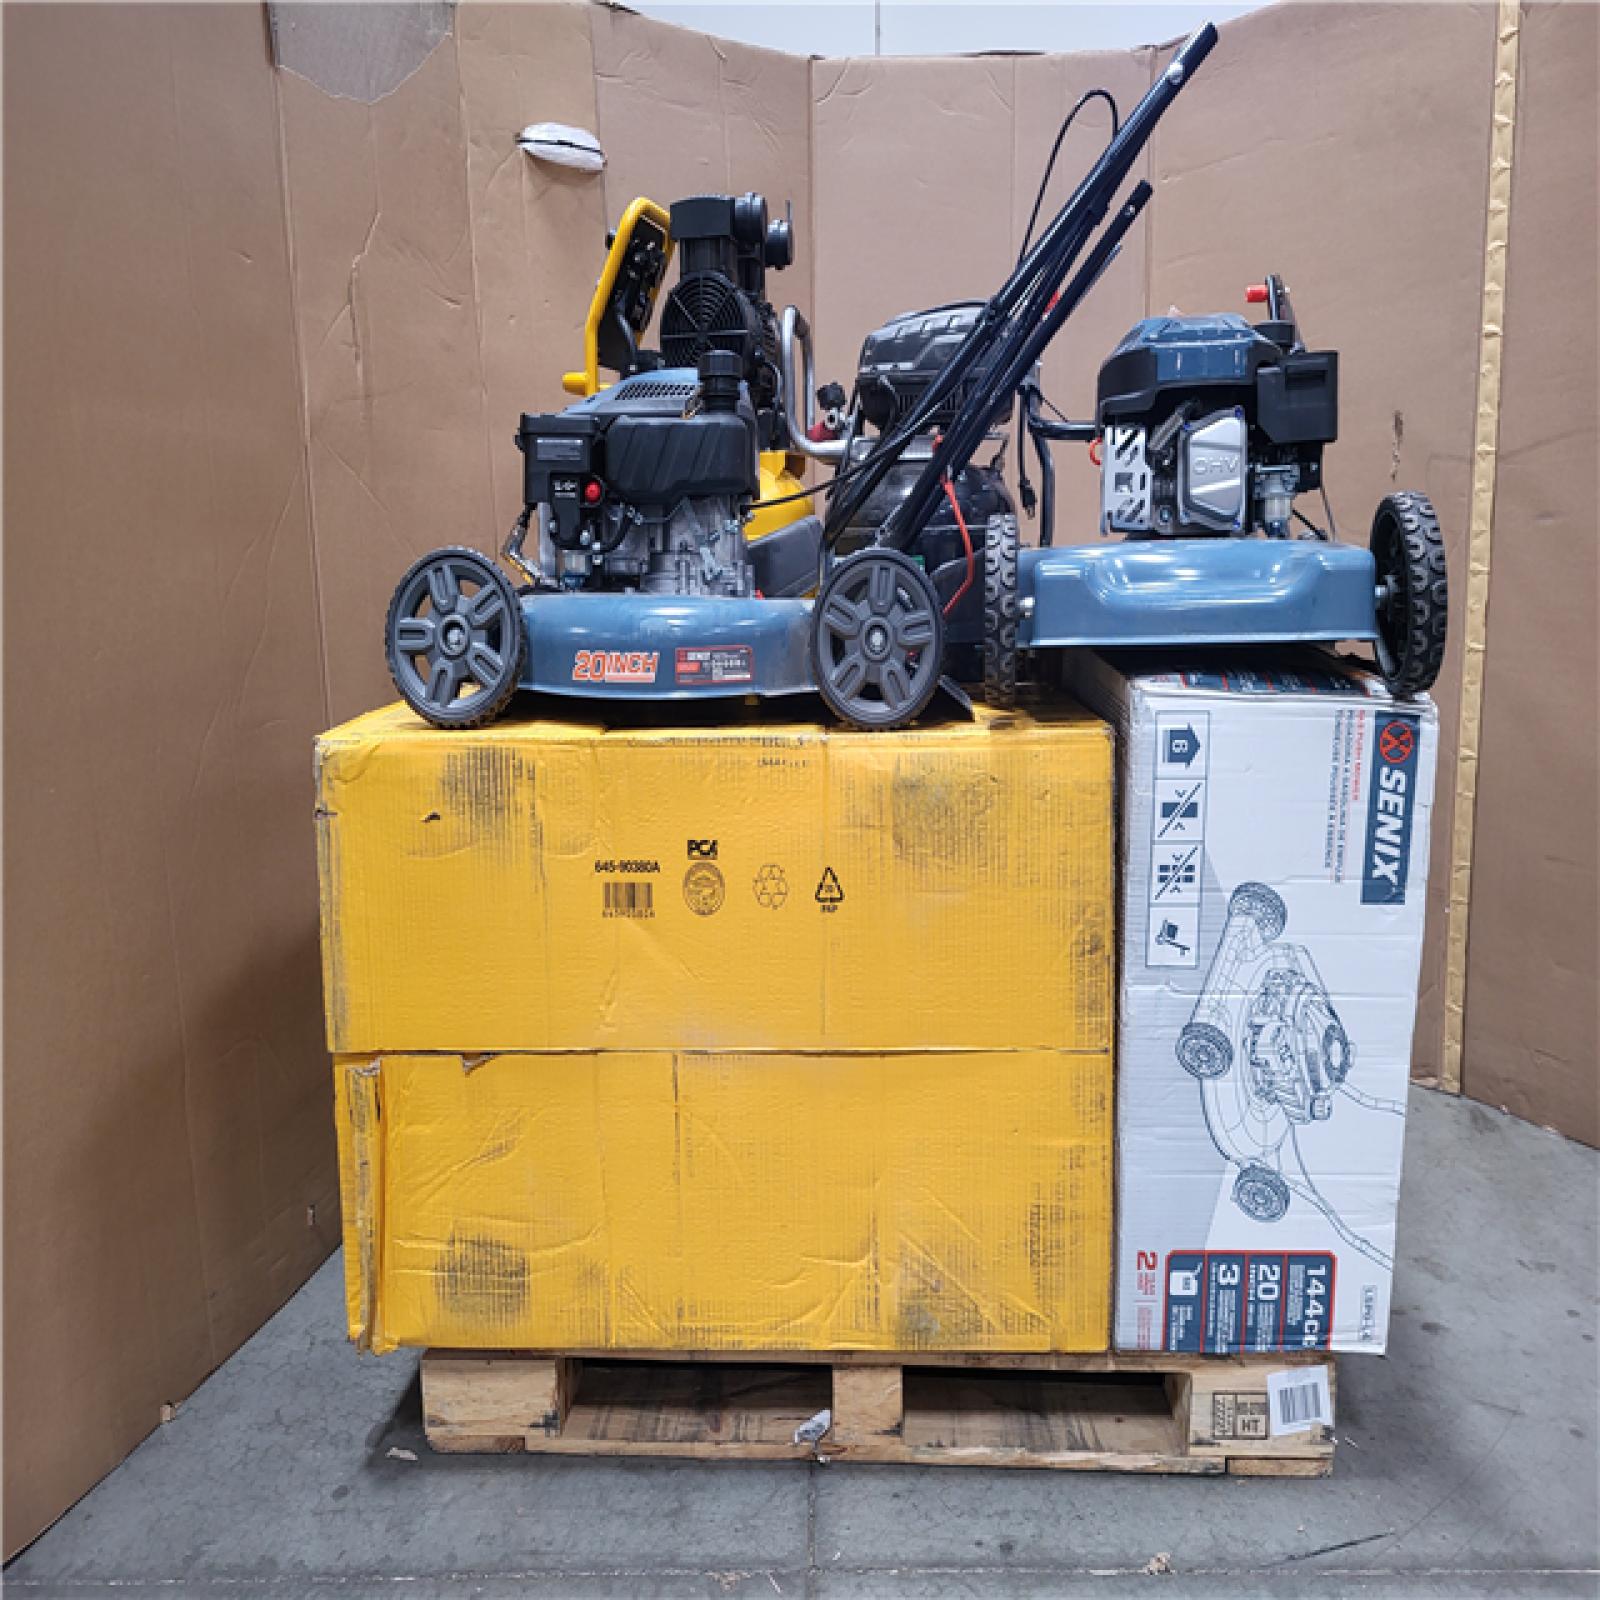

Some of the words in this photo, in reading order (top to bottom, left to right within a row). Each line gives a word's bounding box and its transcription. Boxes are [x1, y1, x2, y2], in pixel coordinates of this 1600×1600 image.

[1193, 454, 1239, 475] OHV
[1371, 766, 1406, 886] SENIX
[1136, 1250, 1158, 1271] 2
[1219, 1264, 1241, 1286] 3
[1258, 1264, 1281, 1301] 20
[1241, 1419, 1261, 1432] HT
